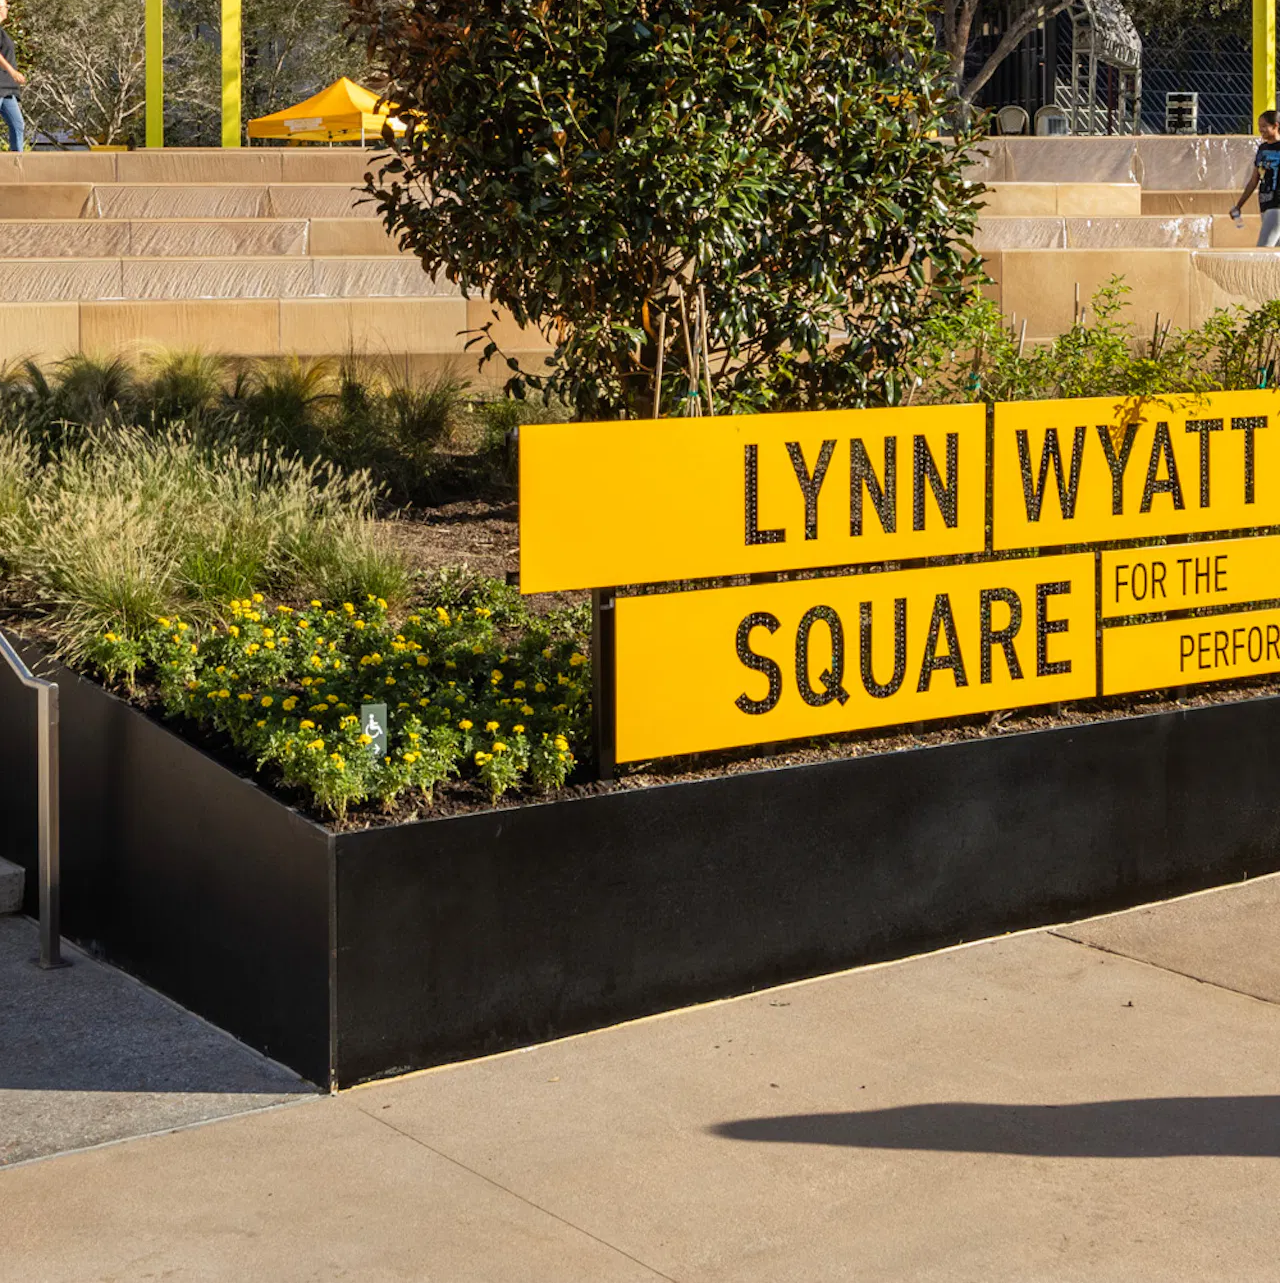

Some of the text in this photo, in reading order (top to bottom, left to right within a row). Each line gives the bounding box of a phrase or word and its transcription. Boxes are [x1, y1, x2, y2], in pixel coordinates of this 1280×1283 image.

[744, 415, 1269, 547] LYNN WYATT
[1115, 554, 1228, 603] FOR THE
[734, 580, 1072, 716] SQUARE
